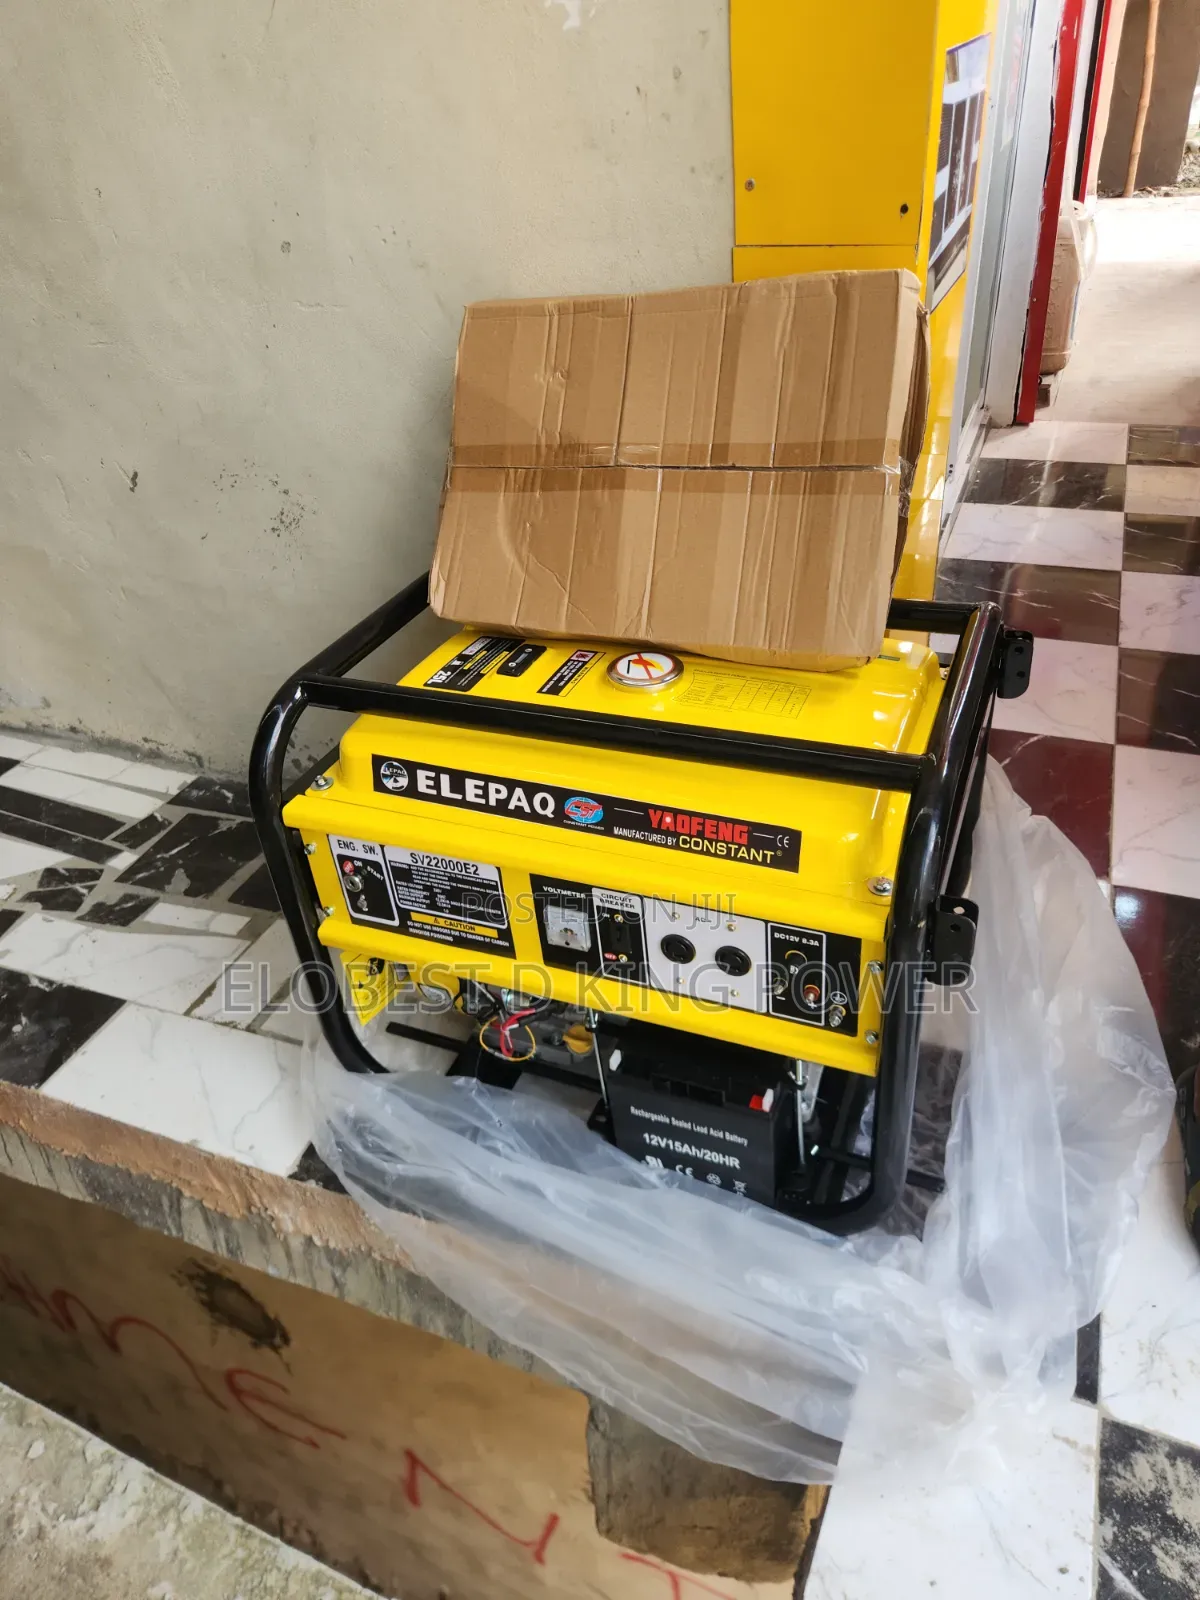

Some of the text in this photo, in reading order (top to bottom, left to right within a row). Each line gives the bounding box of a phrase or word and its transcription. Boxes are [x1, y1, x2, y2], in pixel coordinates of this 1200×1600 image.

[416, 768, 556, 818] ELEPAQ
[648, 808, 749, 845] YAOFENG
[337, 839, 379, 856] ENG. SW.
[613, 826, 775, 864] MANUFACTURED BY CONSTANT
[409, 852, 480, 876] SV22000E2
[366, 865, 384, 881] START
[543, 885, 587, 899] VOLTMETER
[601, 892, 633, 904] CIRCUIT
[599, 898, 636, 910] BREAKER
[444, 920, 476, 932] CAUTION
[774, 932, 820, 947] DC12V 8.3A
[630, 1105, 748, 1148] Rechargeable Sealed Lead Acid Battery
[643, 1132, 741, 1170] 12V15Ah/20HR
